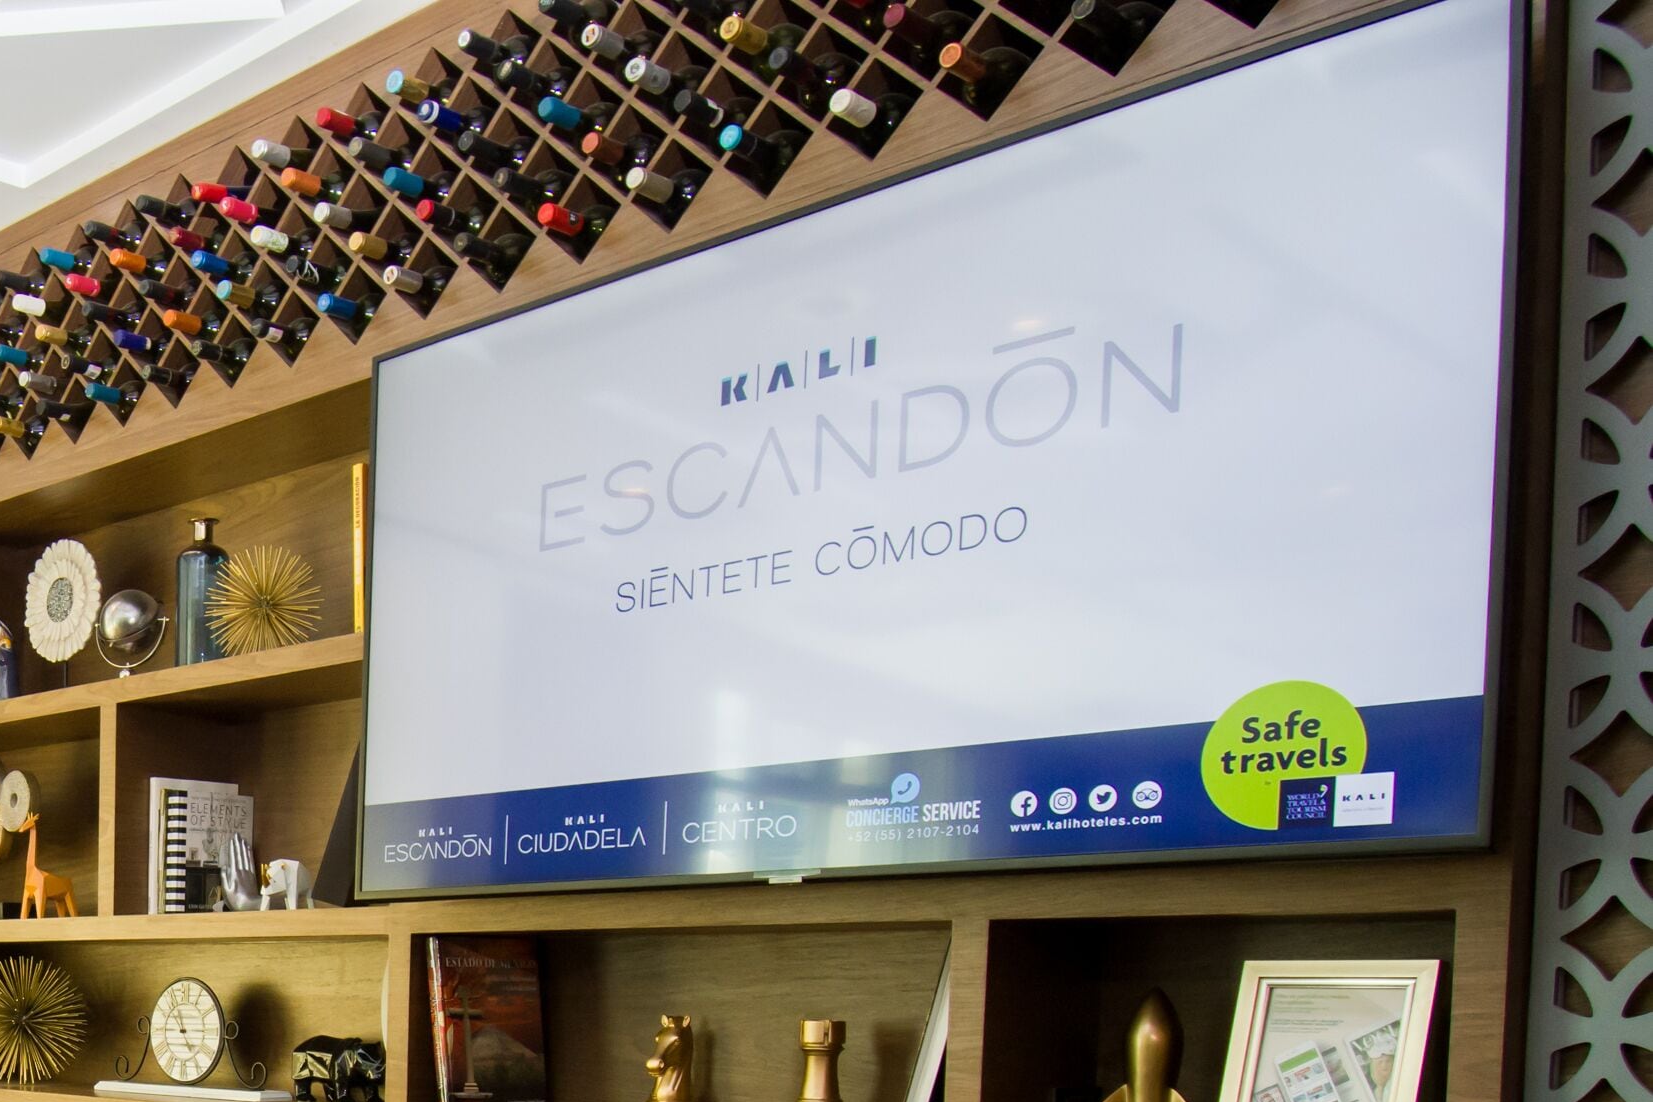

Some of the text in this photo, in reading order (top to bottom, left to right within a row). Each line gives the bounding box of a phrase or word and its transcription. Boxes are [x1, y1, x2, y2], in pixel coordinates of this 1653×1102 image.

[1241, 709, 1322, 744] Safe
[1220, 738, 1348, 775] travels
[190, 802, 247, 817] ELEMENTS
[846, 799, 981, 828] CONCIERGE SERVICE
[847, 797, 889, 807] WhatsApp
[190, 814, 247, 829] OF STYLE
[682, 814, 797, 845] CENTRO
[875, 828, 902, 842] (55)
[907, 823, 980, 840] 2107-2104
[1010, 814, 1163, 833] www.kalihoteles.com
[517, 826, 647, 855] CIUDADELA
